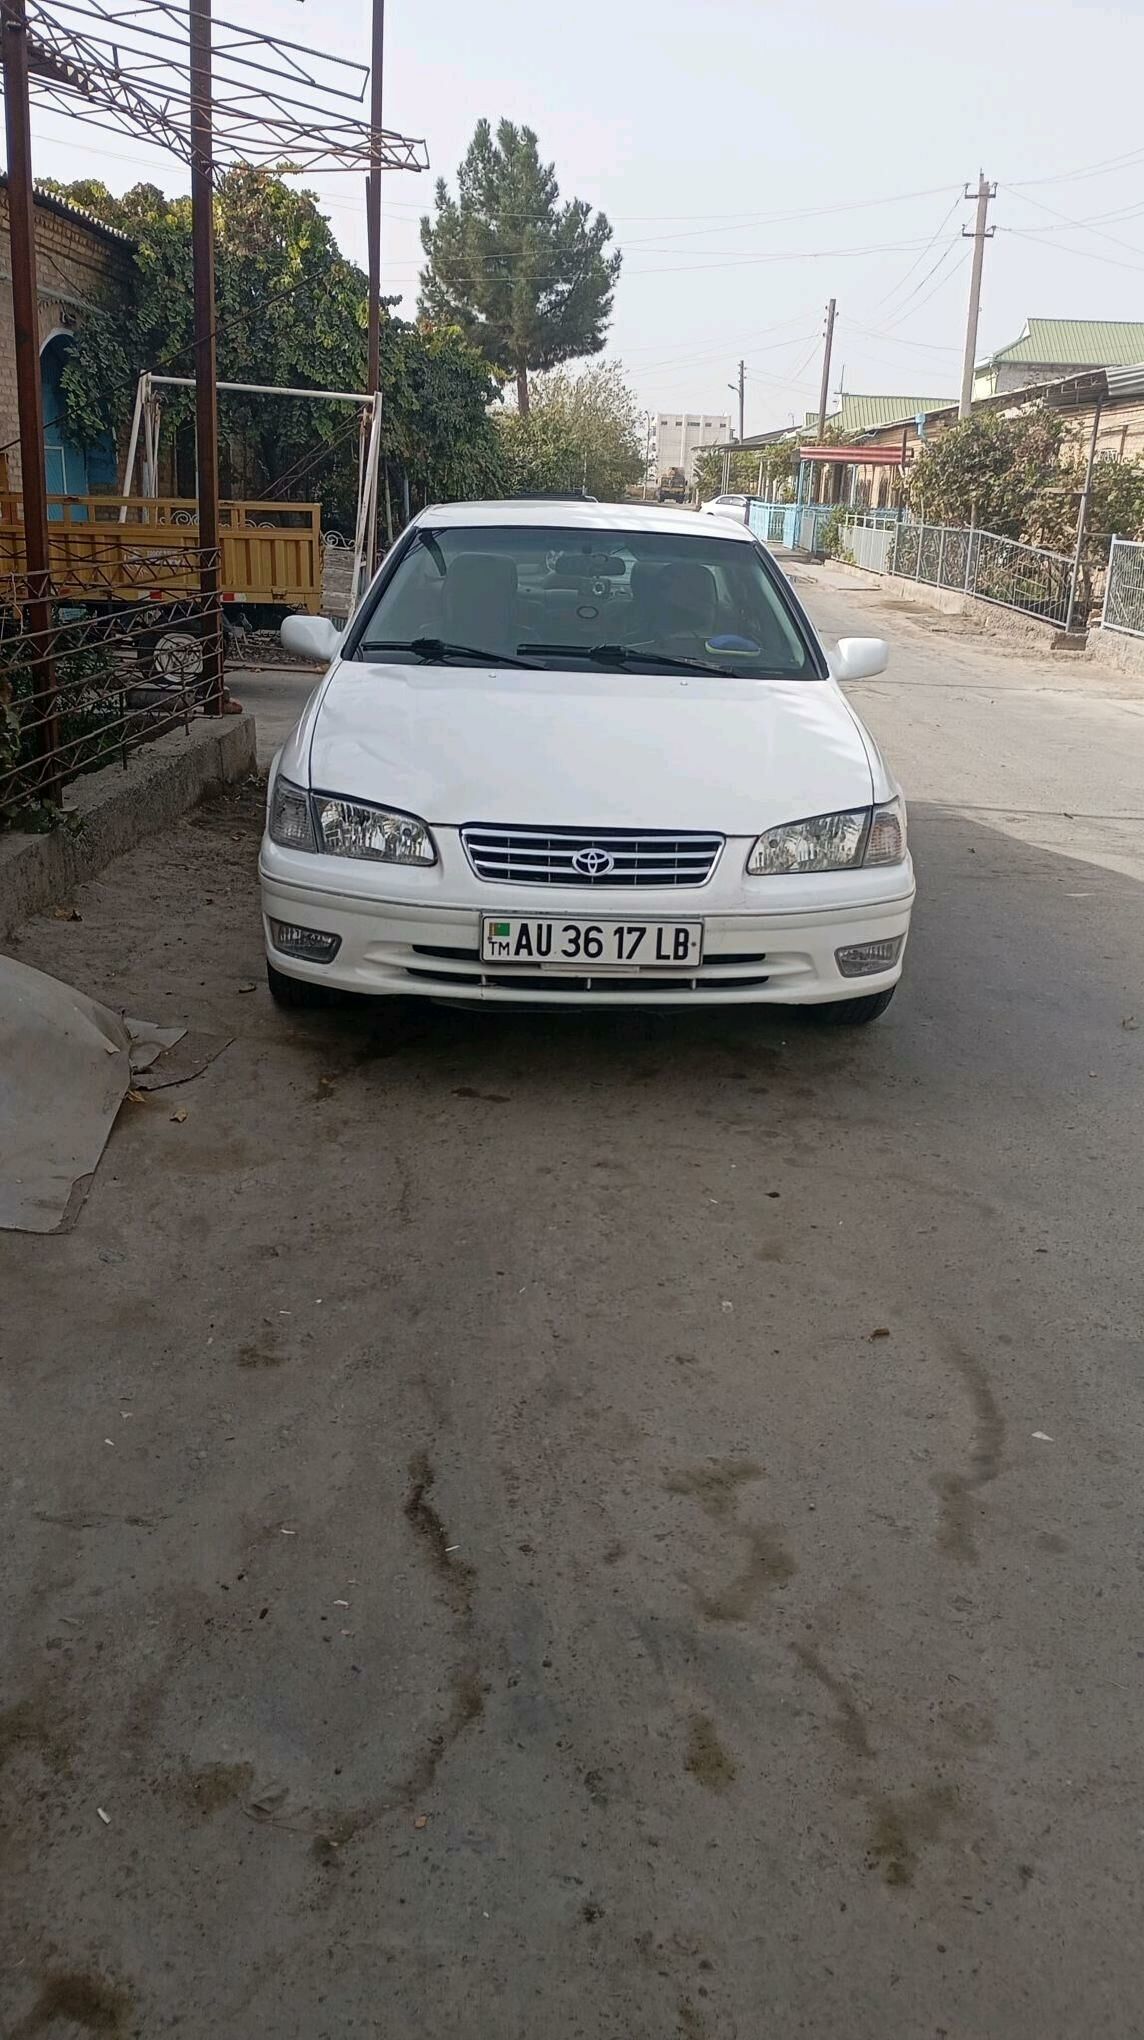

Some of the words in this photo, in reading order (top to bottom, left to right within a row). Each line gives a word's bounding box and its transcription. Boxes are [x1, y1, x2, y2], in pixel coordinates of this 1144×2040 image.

[489, 941, 510, 956] TM
[514, 923, 553, 956] AU
[561, 925, 604, 959] 36
[613, 926, 647, 960] 17
[655, 927, 690, 961] LB
